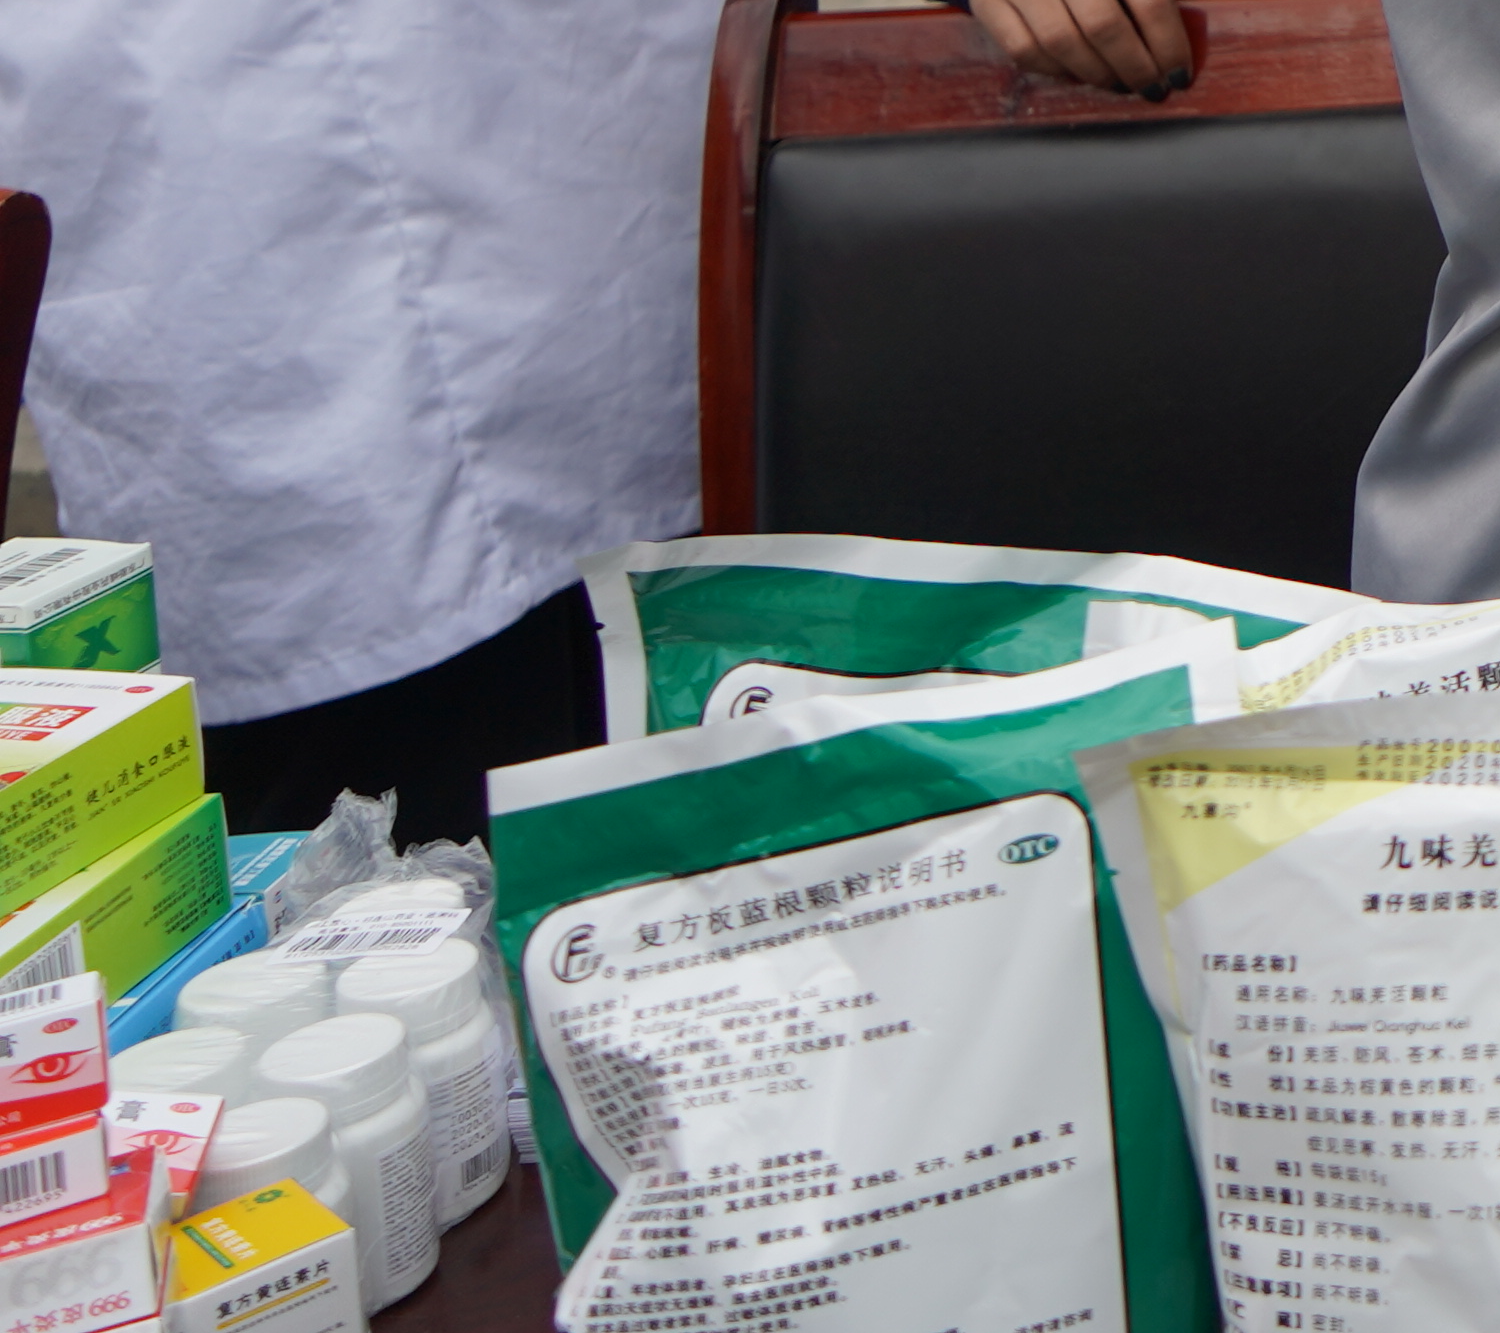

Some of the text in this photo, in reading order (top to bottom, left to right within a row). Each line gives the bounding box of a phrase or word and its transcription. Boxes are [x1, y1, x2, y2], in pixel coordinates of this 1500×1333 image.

[86, 734, 191, 807] 健儿消食口服液
[1001, 835, 1058, 863] OTC
[633, 848, 967, 953] 复方板蓝根颗粒说明书
[215, 1257, 331, 1319] 复方黄连素片
